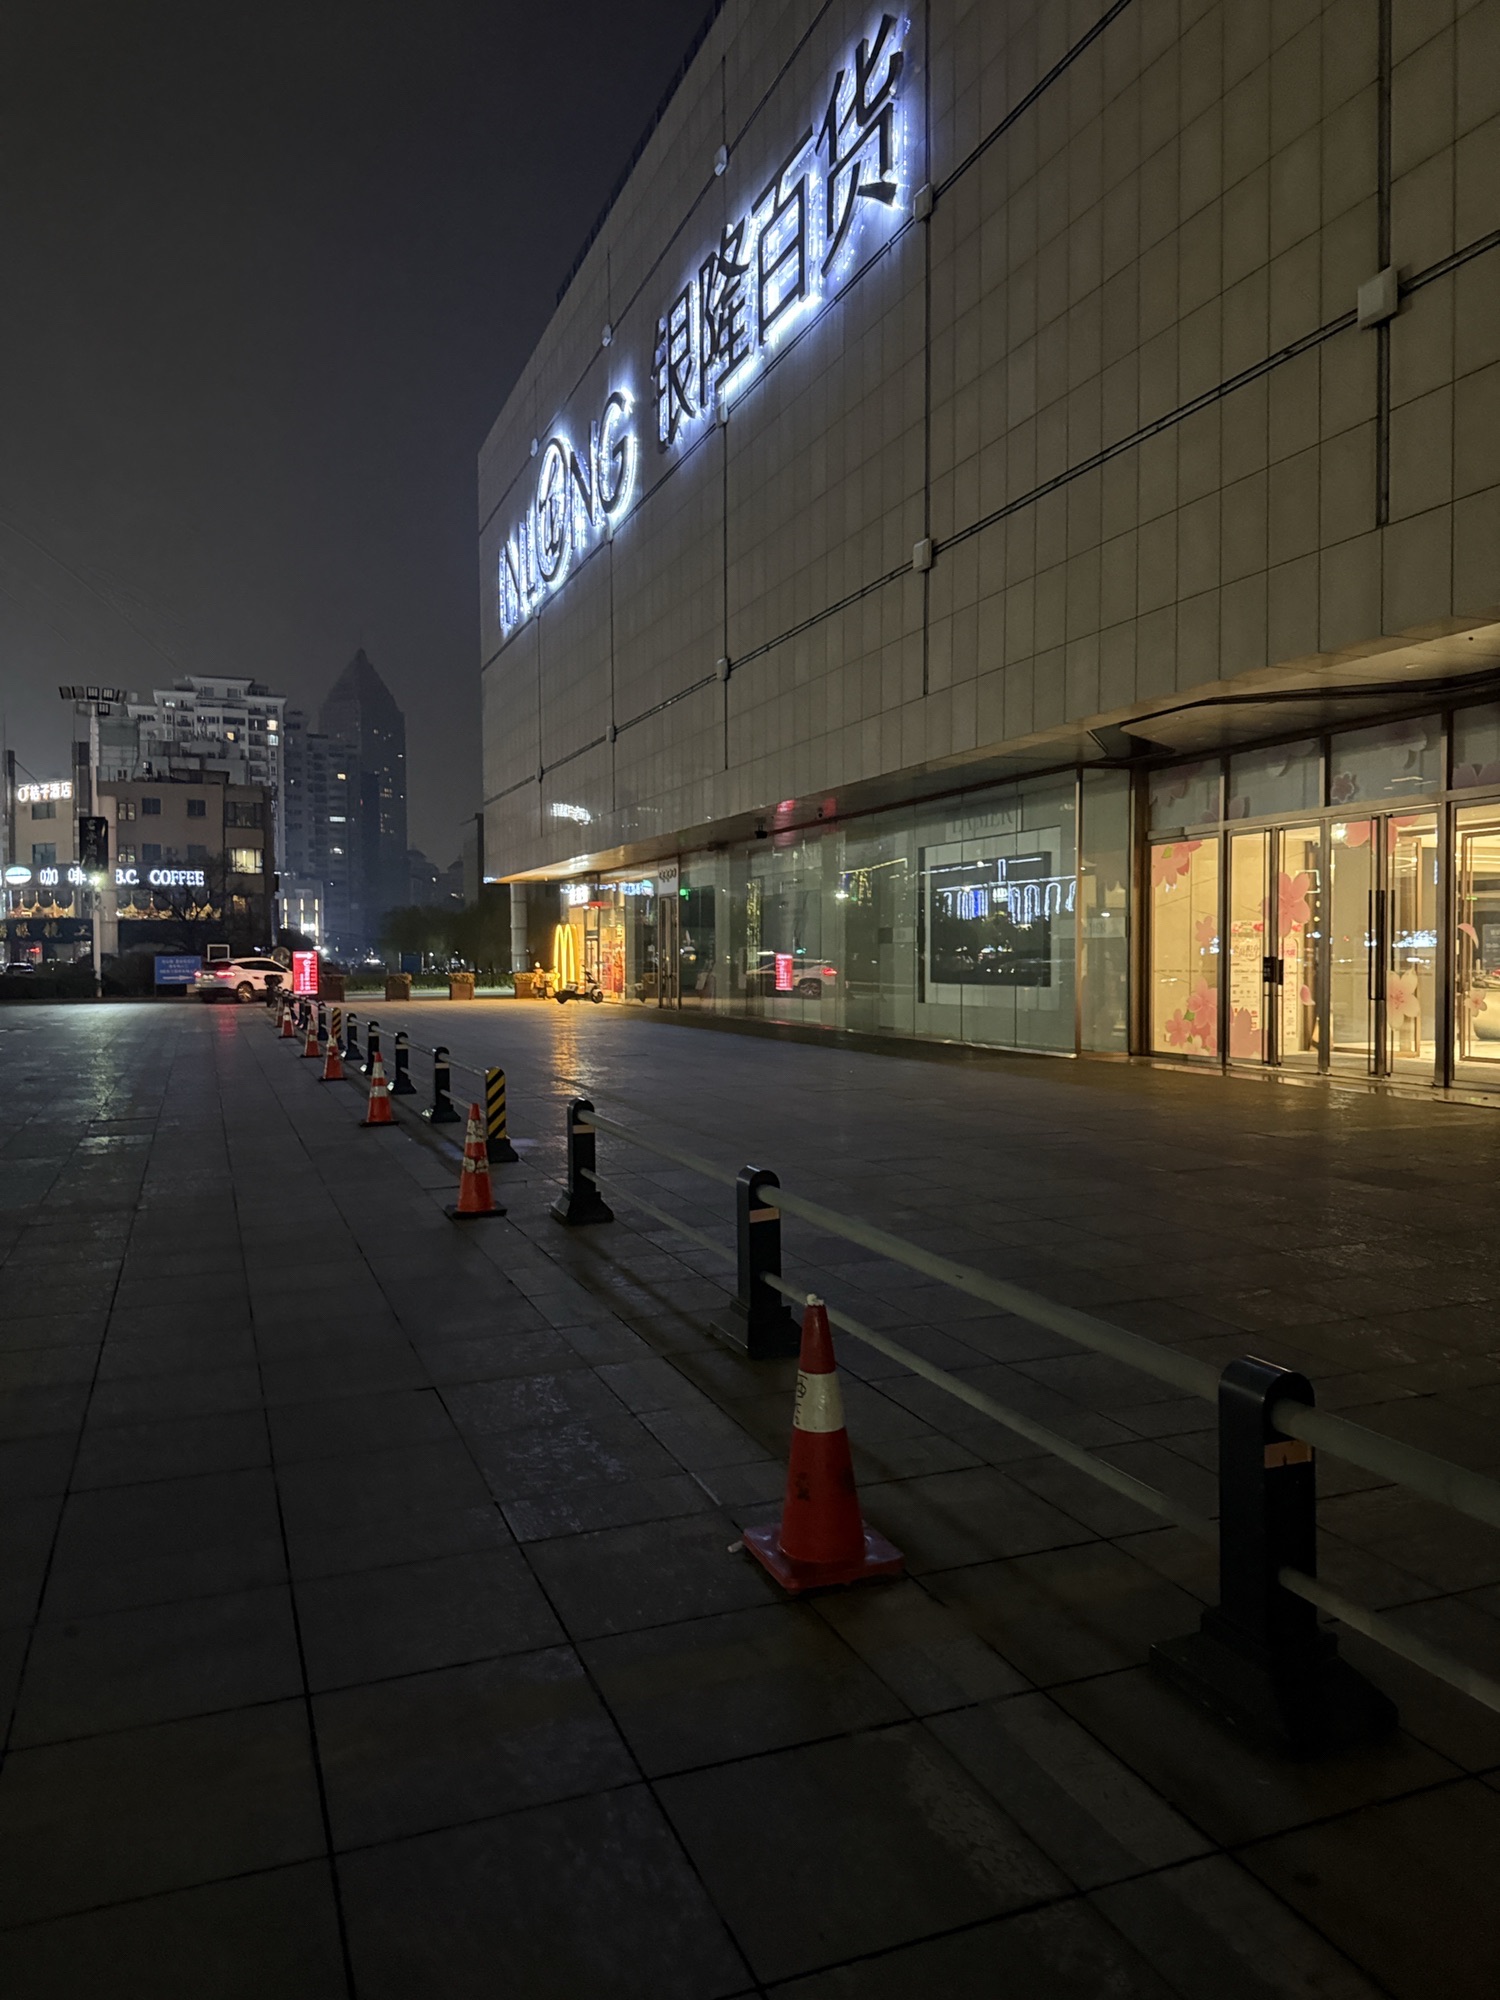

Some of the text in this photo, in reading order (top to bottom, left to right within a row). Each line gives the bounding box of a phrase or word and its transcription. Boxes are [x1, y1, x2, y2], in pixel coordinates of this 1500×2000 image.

[652, 13, 904, 448] 银隆百货
[149, 868, 205, 886] COFFEE
